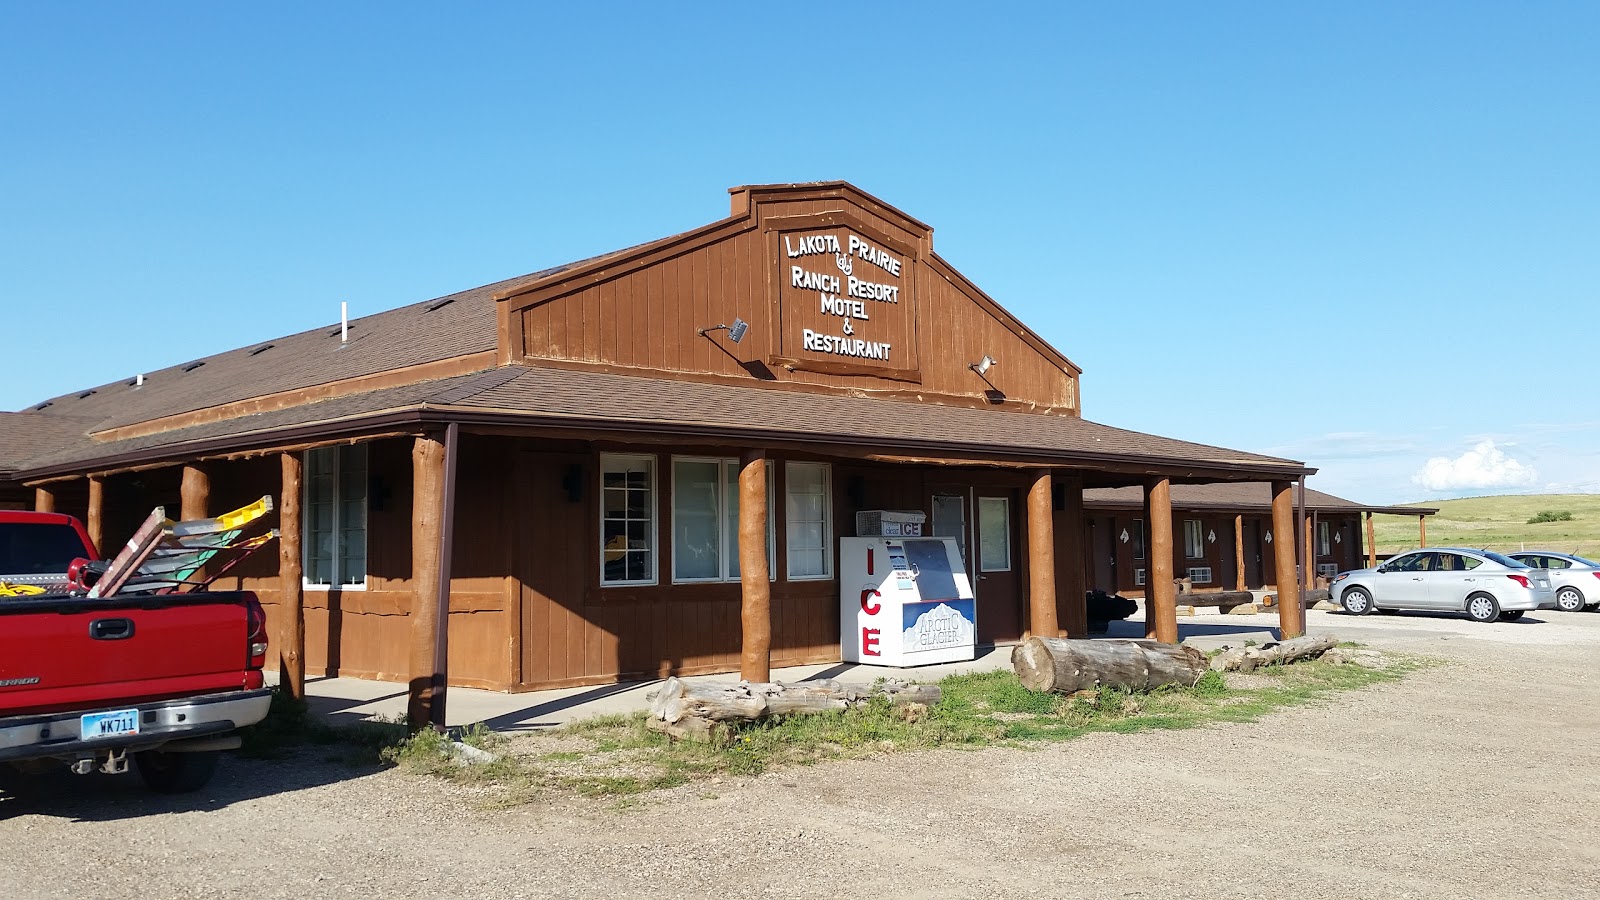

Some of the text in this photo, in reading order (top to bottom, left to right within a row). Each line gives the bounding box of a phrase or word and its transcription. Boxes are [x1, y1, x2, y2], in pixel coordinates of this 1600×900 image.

[785, 234, 901, 277] LAKOTA PRAIRIE
[791, 265, 899, 303] RANCH RESORT
[821, 293, 869, 320] MOTEL
[843, 317, 854, 335] &
[803, 328, 891, 361] RESTAURANT
[900, 523, 919, 535] ICE
[920, 613, 959, 633] ARCTIC
[920, 631, 959, 645] GLACIER
[100, 718, 135, 733] WK711
